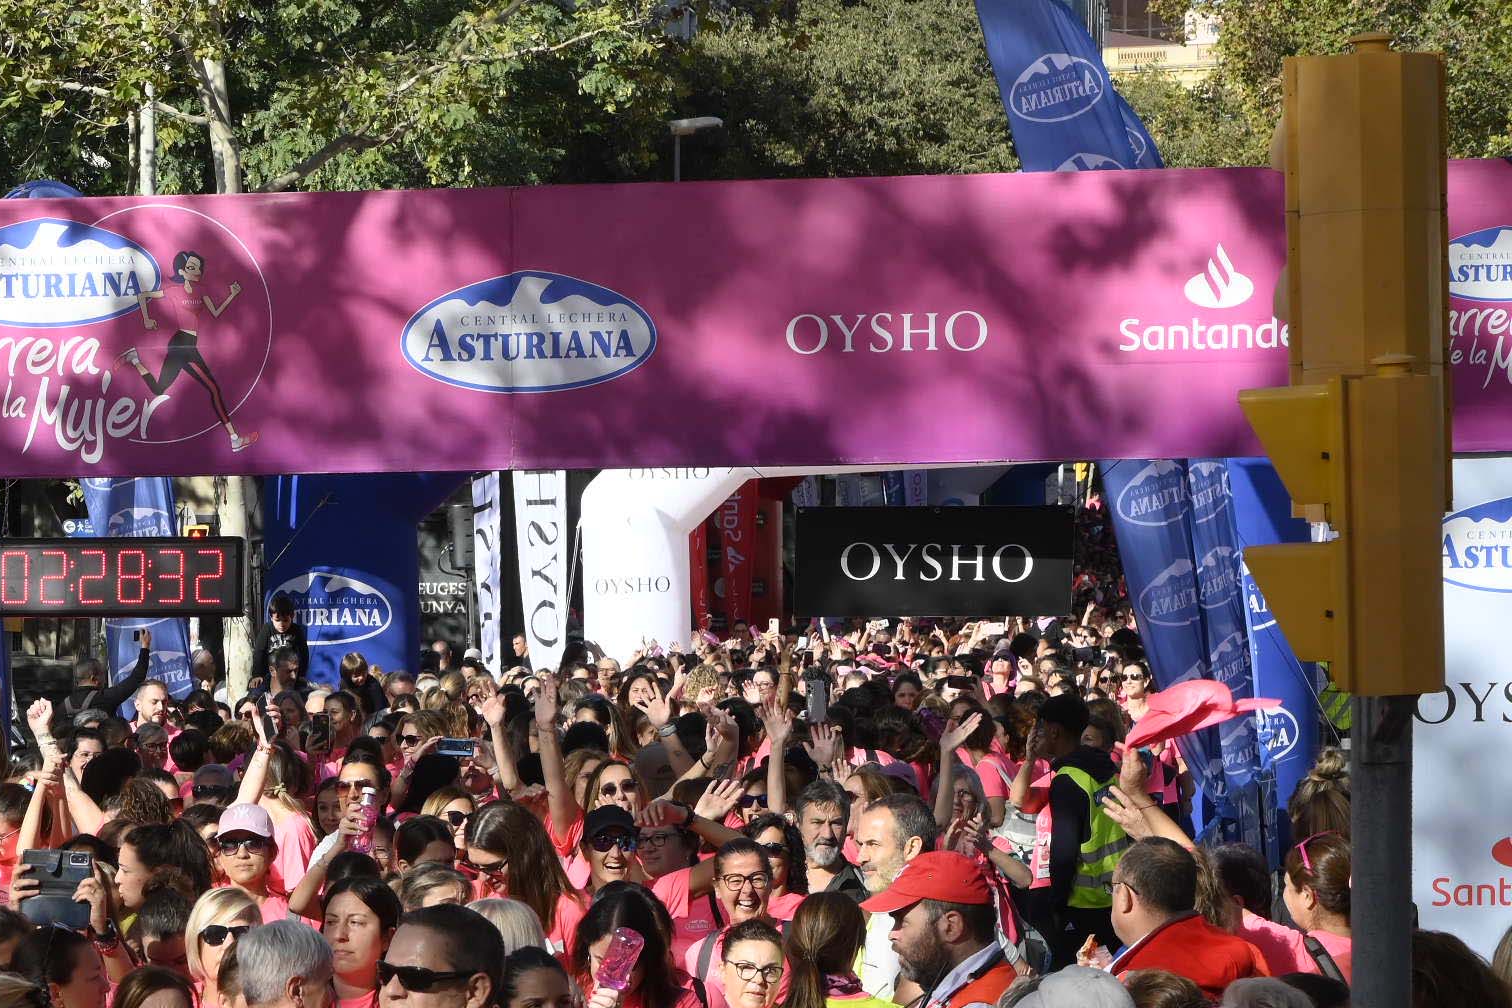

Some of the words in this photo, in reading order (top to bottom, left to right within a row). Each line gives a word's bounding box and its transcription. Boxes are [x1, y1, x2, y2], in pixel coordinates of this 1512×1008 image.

[459, 313, 537, 326] CENTRAL
[546, 312, 630, 325] LECHERA
[785, 310, 990, 355] OYSHO
[421, 327, 637, 363] ASTURIANA
[1469, 338, 1487, 365] la
[2, 380, 26, 418] la
[21, 370, 171, 464] Mujer
[1, 550, 223, 604] 02:28:32
[840, 542, 1034, 583] OYSHO
[595, 575, 672, 595] OYSHO
